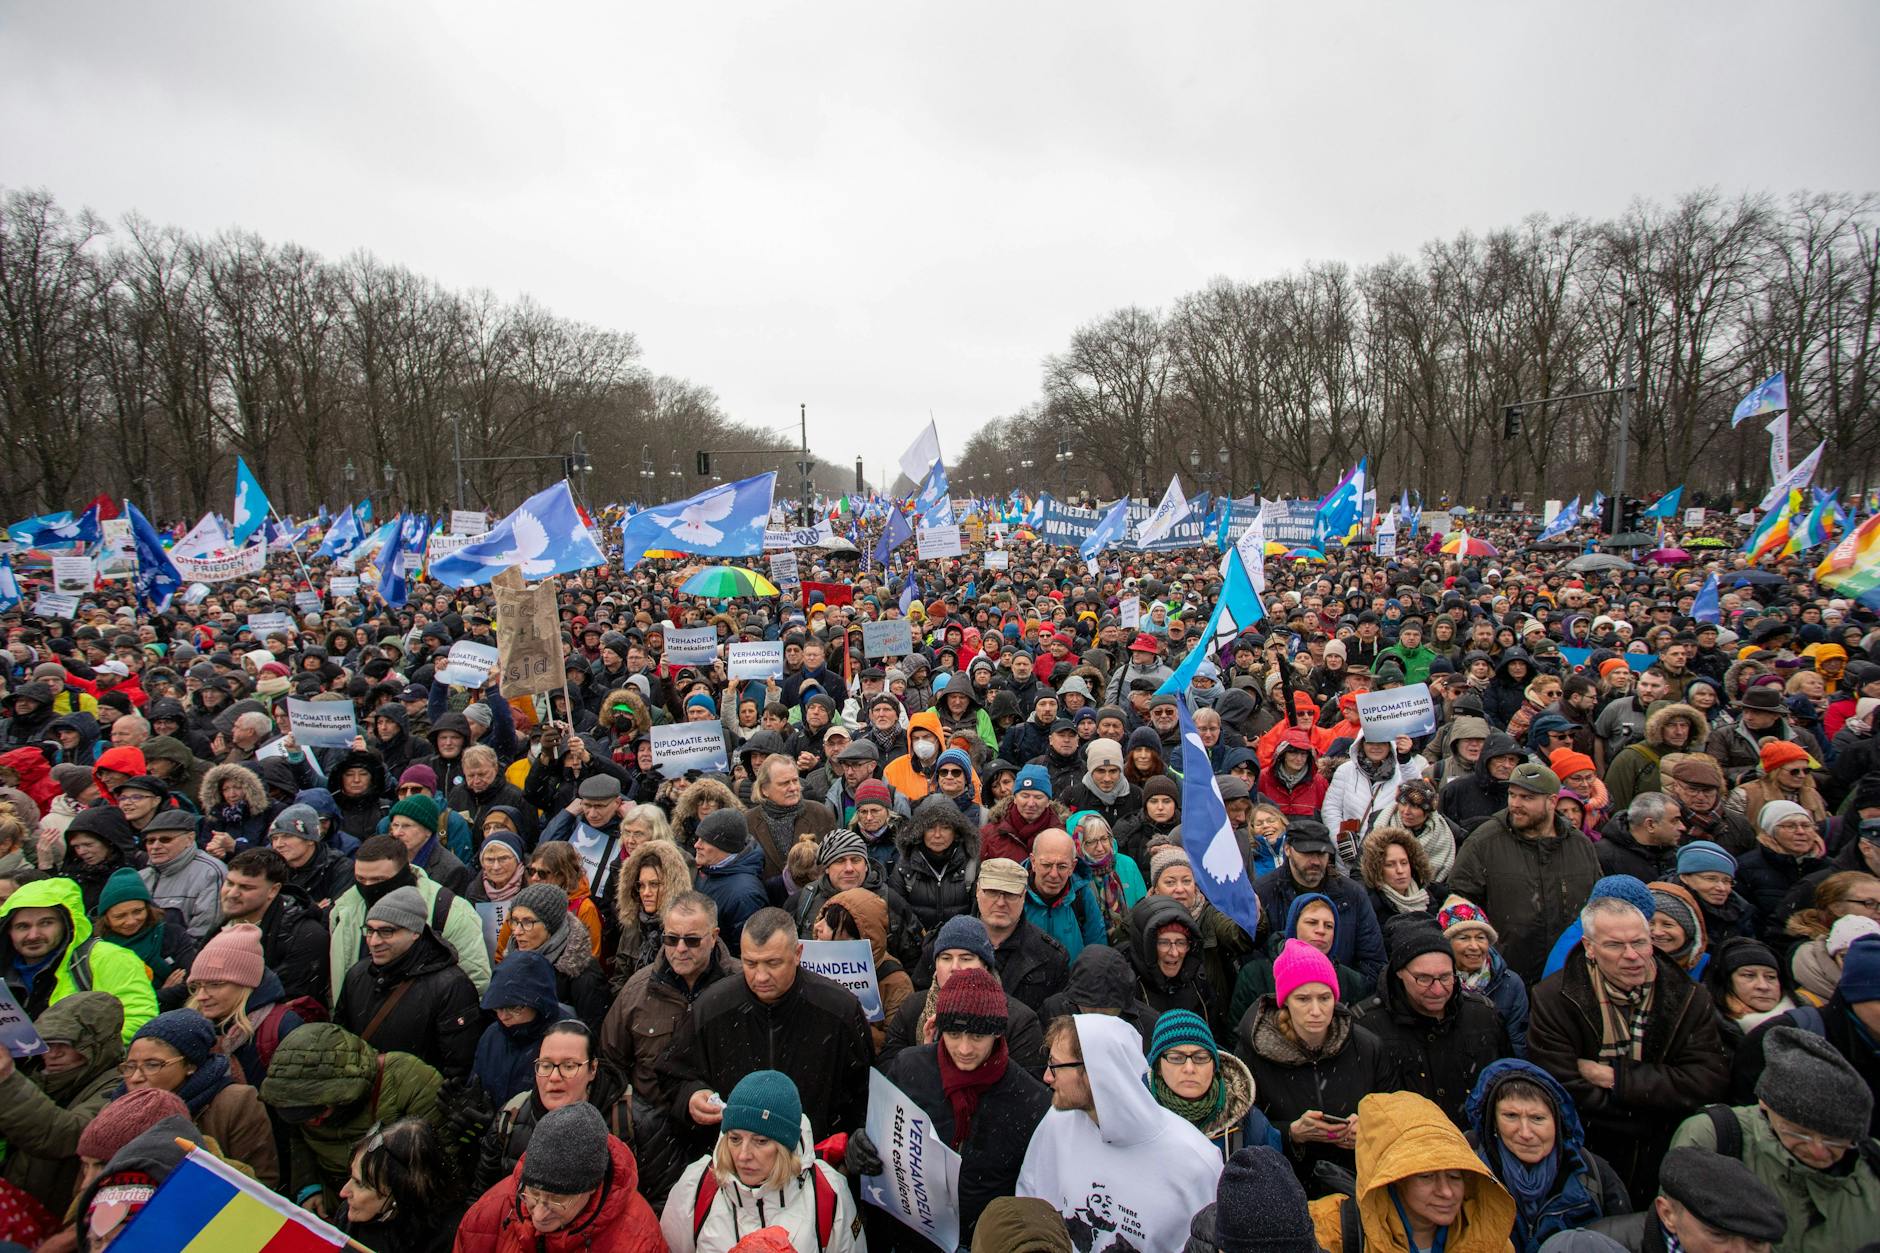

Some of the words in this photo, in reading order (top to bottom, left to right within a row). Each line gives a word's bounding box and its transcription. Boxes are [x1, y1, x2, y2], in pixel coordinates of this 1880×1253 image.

[1049, 500, 1102, 521] FRIEDEN,
[193, 560, 244, 572] FRIEDEN
[666, 636, 715, 644] VERHANDELN
[1362, 700, 1412, 715] DIPLOMATIE
[1413, 698, 1429, 706] statt
[290, 711, 332, 721] DIPLOMATIE
[1364, 707, 1430, 723] Waffenlieferungen
[293, 720, 352, 730] Waffenlieferungen
[654, 736, 703, 748] DIPLOMATIE
[656, 745, 721, 757] Waffenlieferungen
[800, 961, 868, 975] RHANDELN
[892, 1104, 904, 1148] statt
[909, 1117, 936, 1230] VERHANDELN
[892, 1149, 912, 1215] eskalieren
[1118, 1204, 1138, 1219] THERE
[1131, 1220, 1141, 1229] NO
